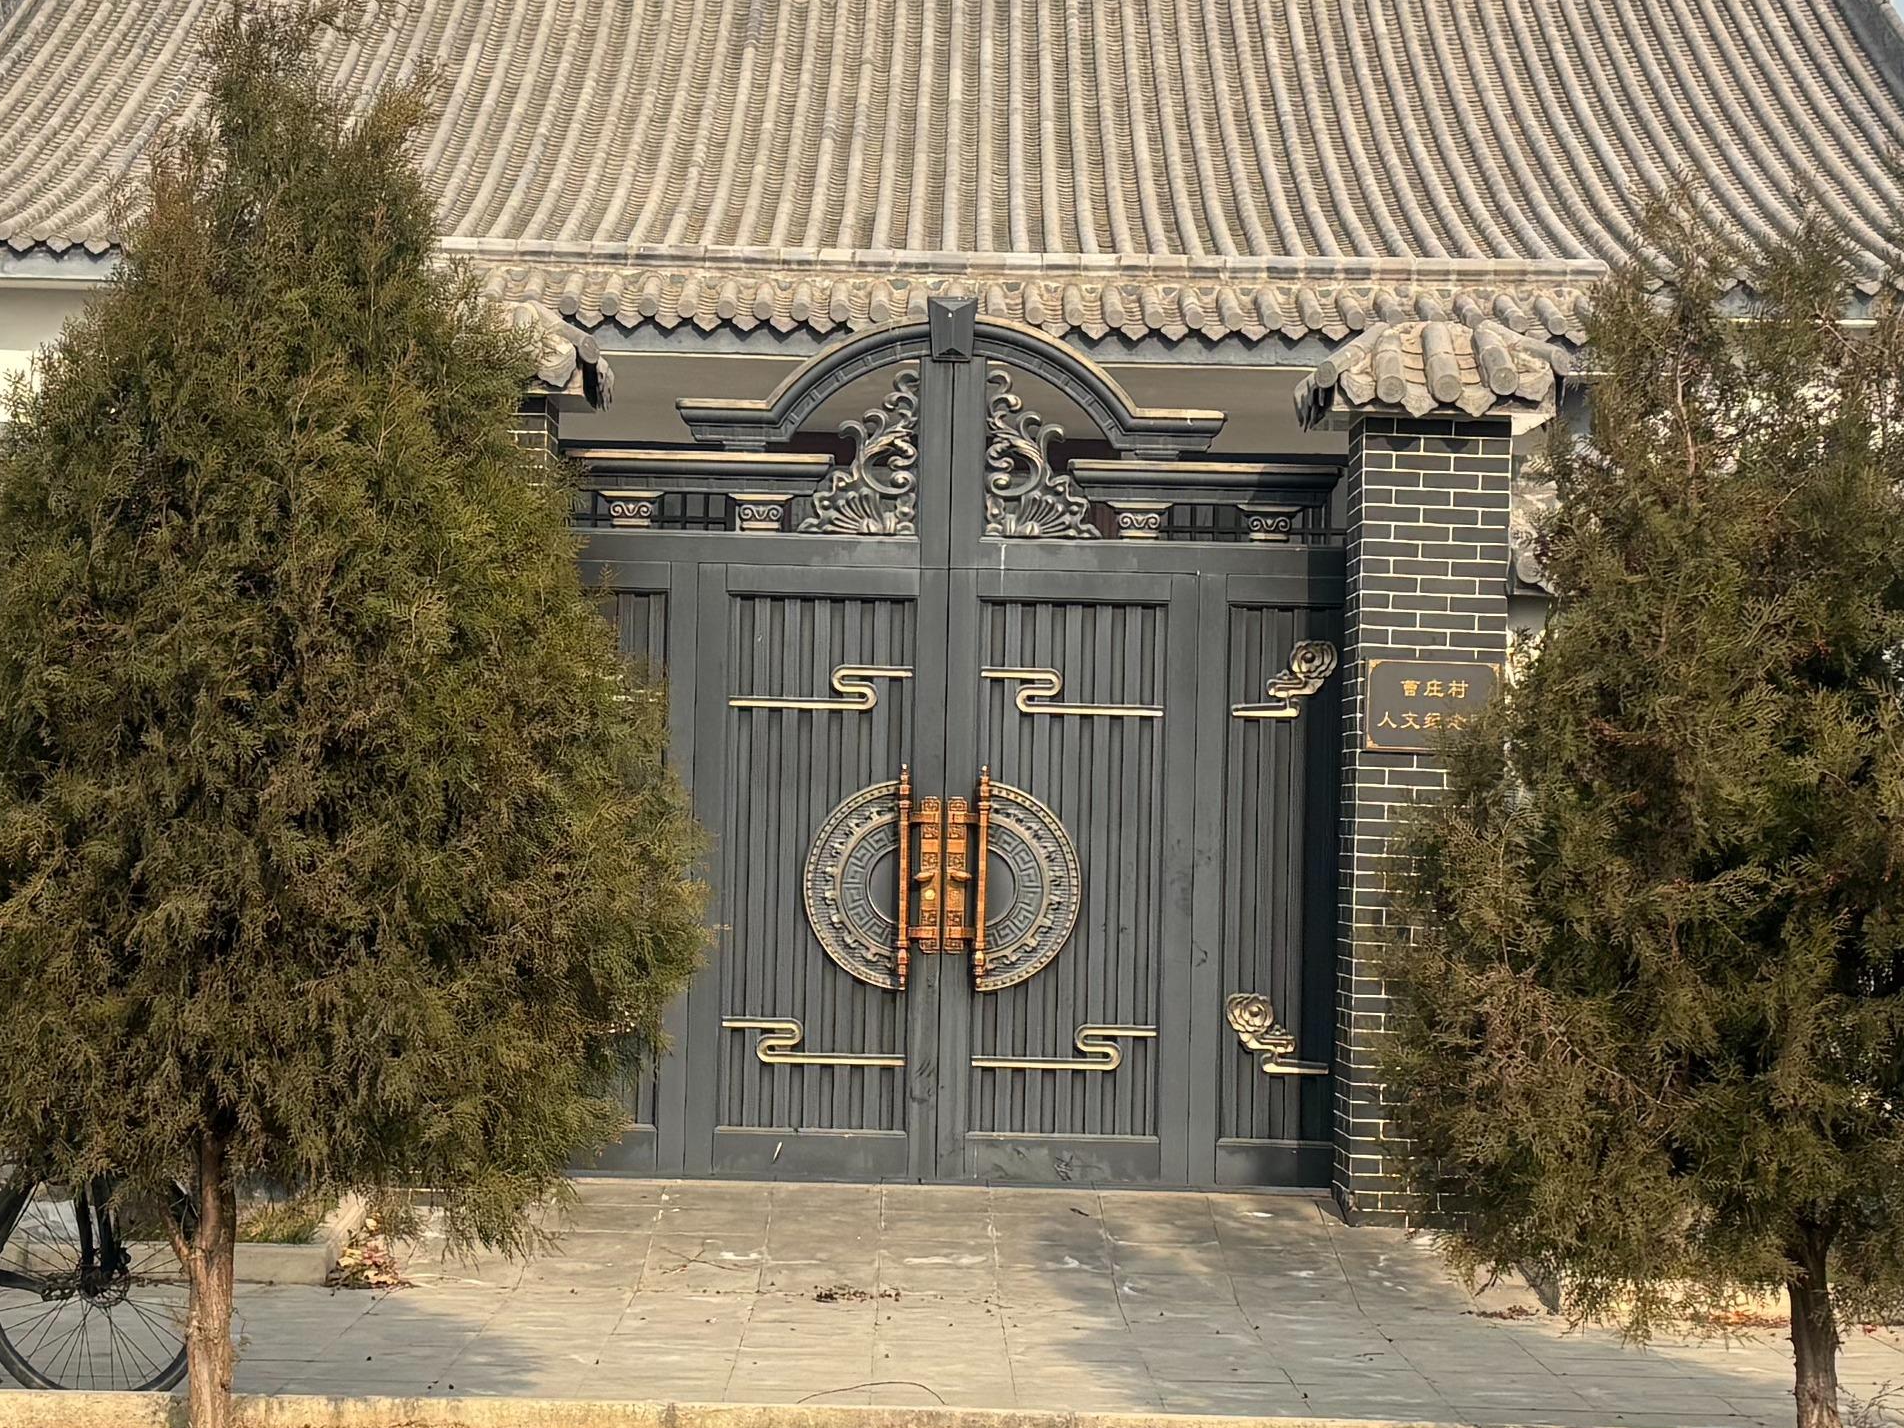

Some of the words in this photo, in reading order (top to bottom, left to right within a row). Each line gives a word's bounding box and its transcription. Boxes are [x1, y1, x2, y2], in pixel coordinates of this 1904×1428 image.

[1400, 679, 1469, 699] 曹庄村
[1377, 711, 1480, 731] 人文纪念
